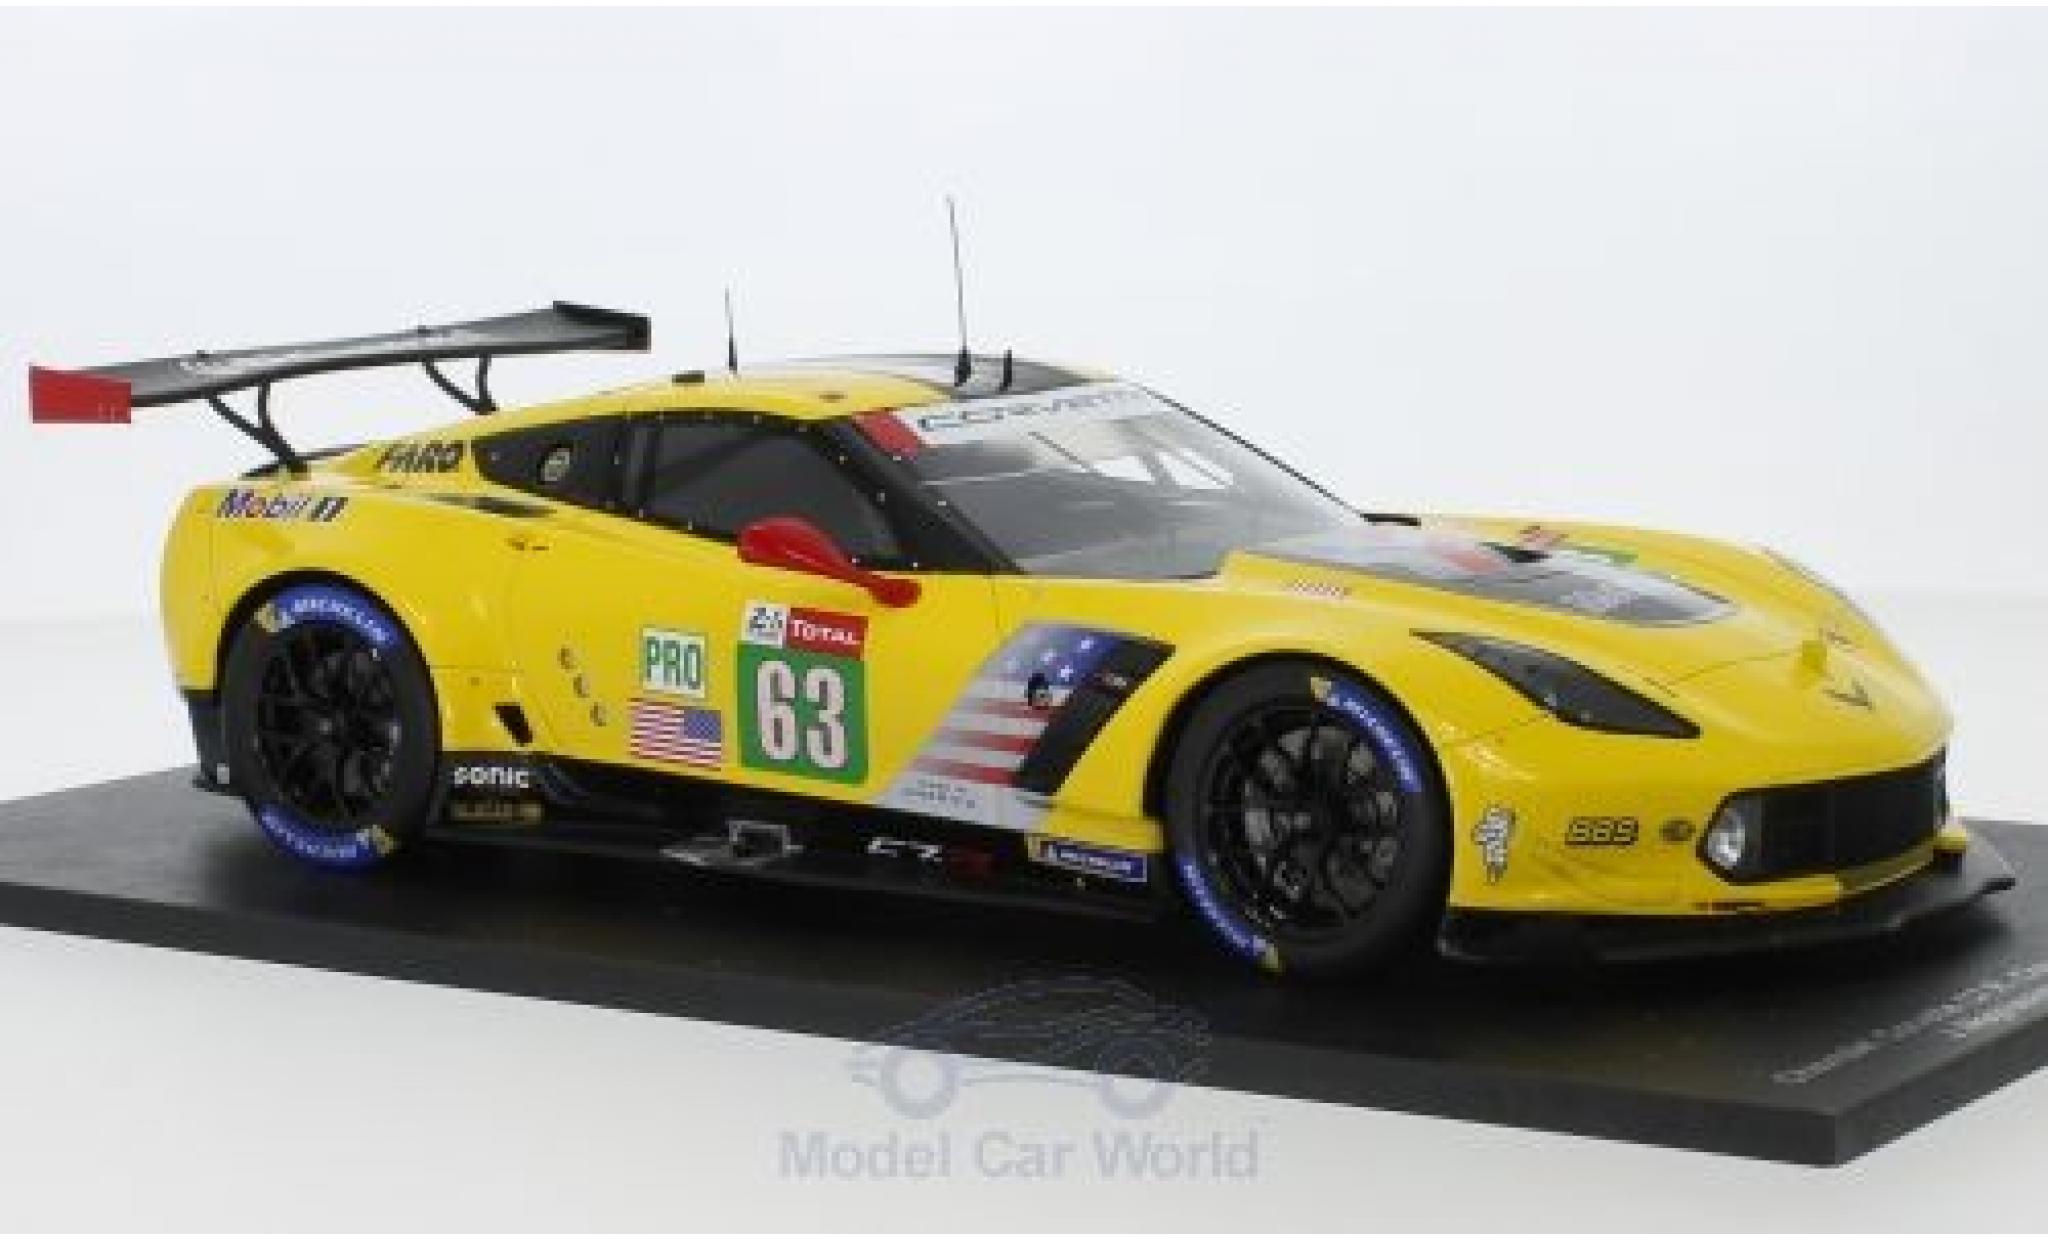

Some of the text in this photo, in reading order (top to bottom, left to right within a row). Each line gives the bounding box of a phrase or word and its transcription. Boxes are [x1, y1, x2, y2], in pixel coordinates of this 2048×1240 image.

[375, 440, 464, 474] FARO
[218, 488, 310, 520] Mobil
[646, 635, 703, 691] PRO
[757, 659, 846, 769] 63
